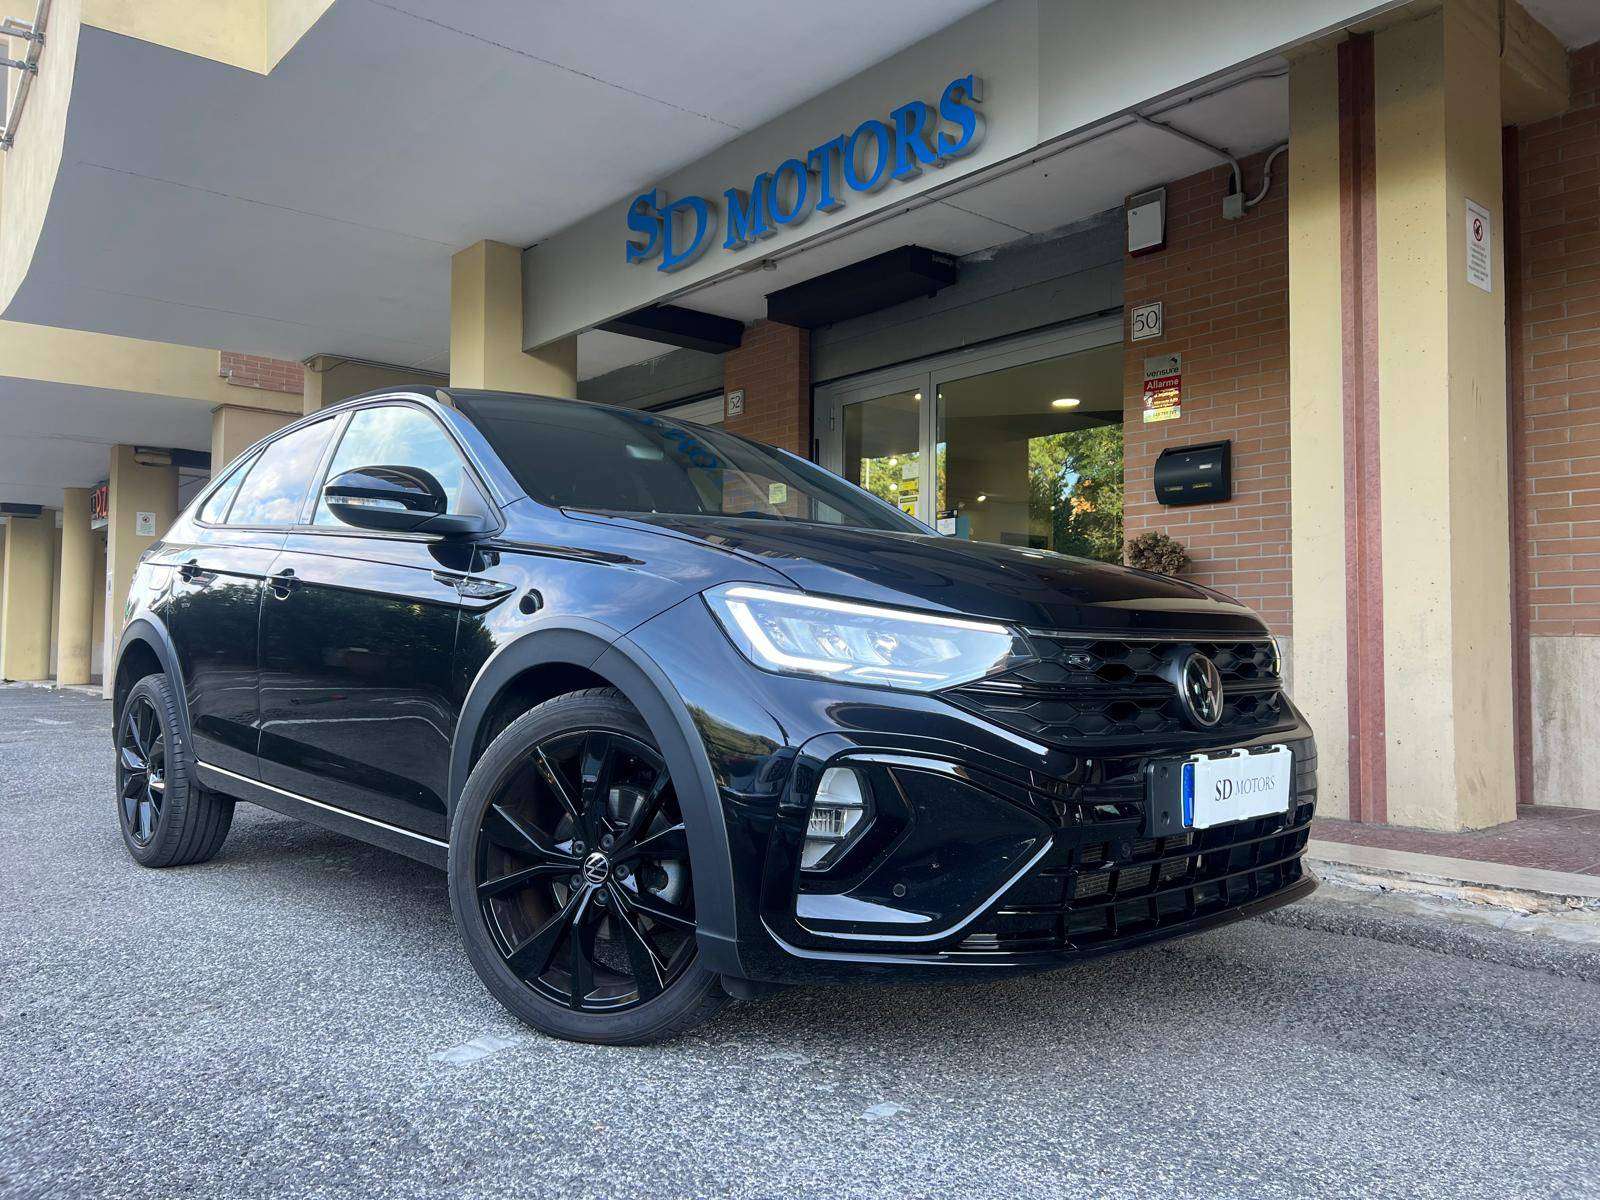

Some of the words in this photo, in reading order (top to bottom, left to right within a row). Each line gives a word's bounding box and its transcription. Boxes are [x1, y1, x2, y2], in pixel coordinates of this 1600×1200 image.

[626, 187, 710, 272] SD
[723, 74, 980, 250] MOTORS
[1134, 310, 1158, 333] 50
[1146, 378, 1179, 390] Allarme
[730, 395, 741, 409] 52
[1215, 778, 1233, 801] SD
[1235, 775, 1276, 796] MOTORS
